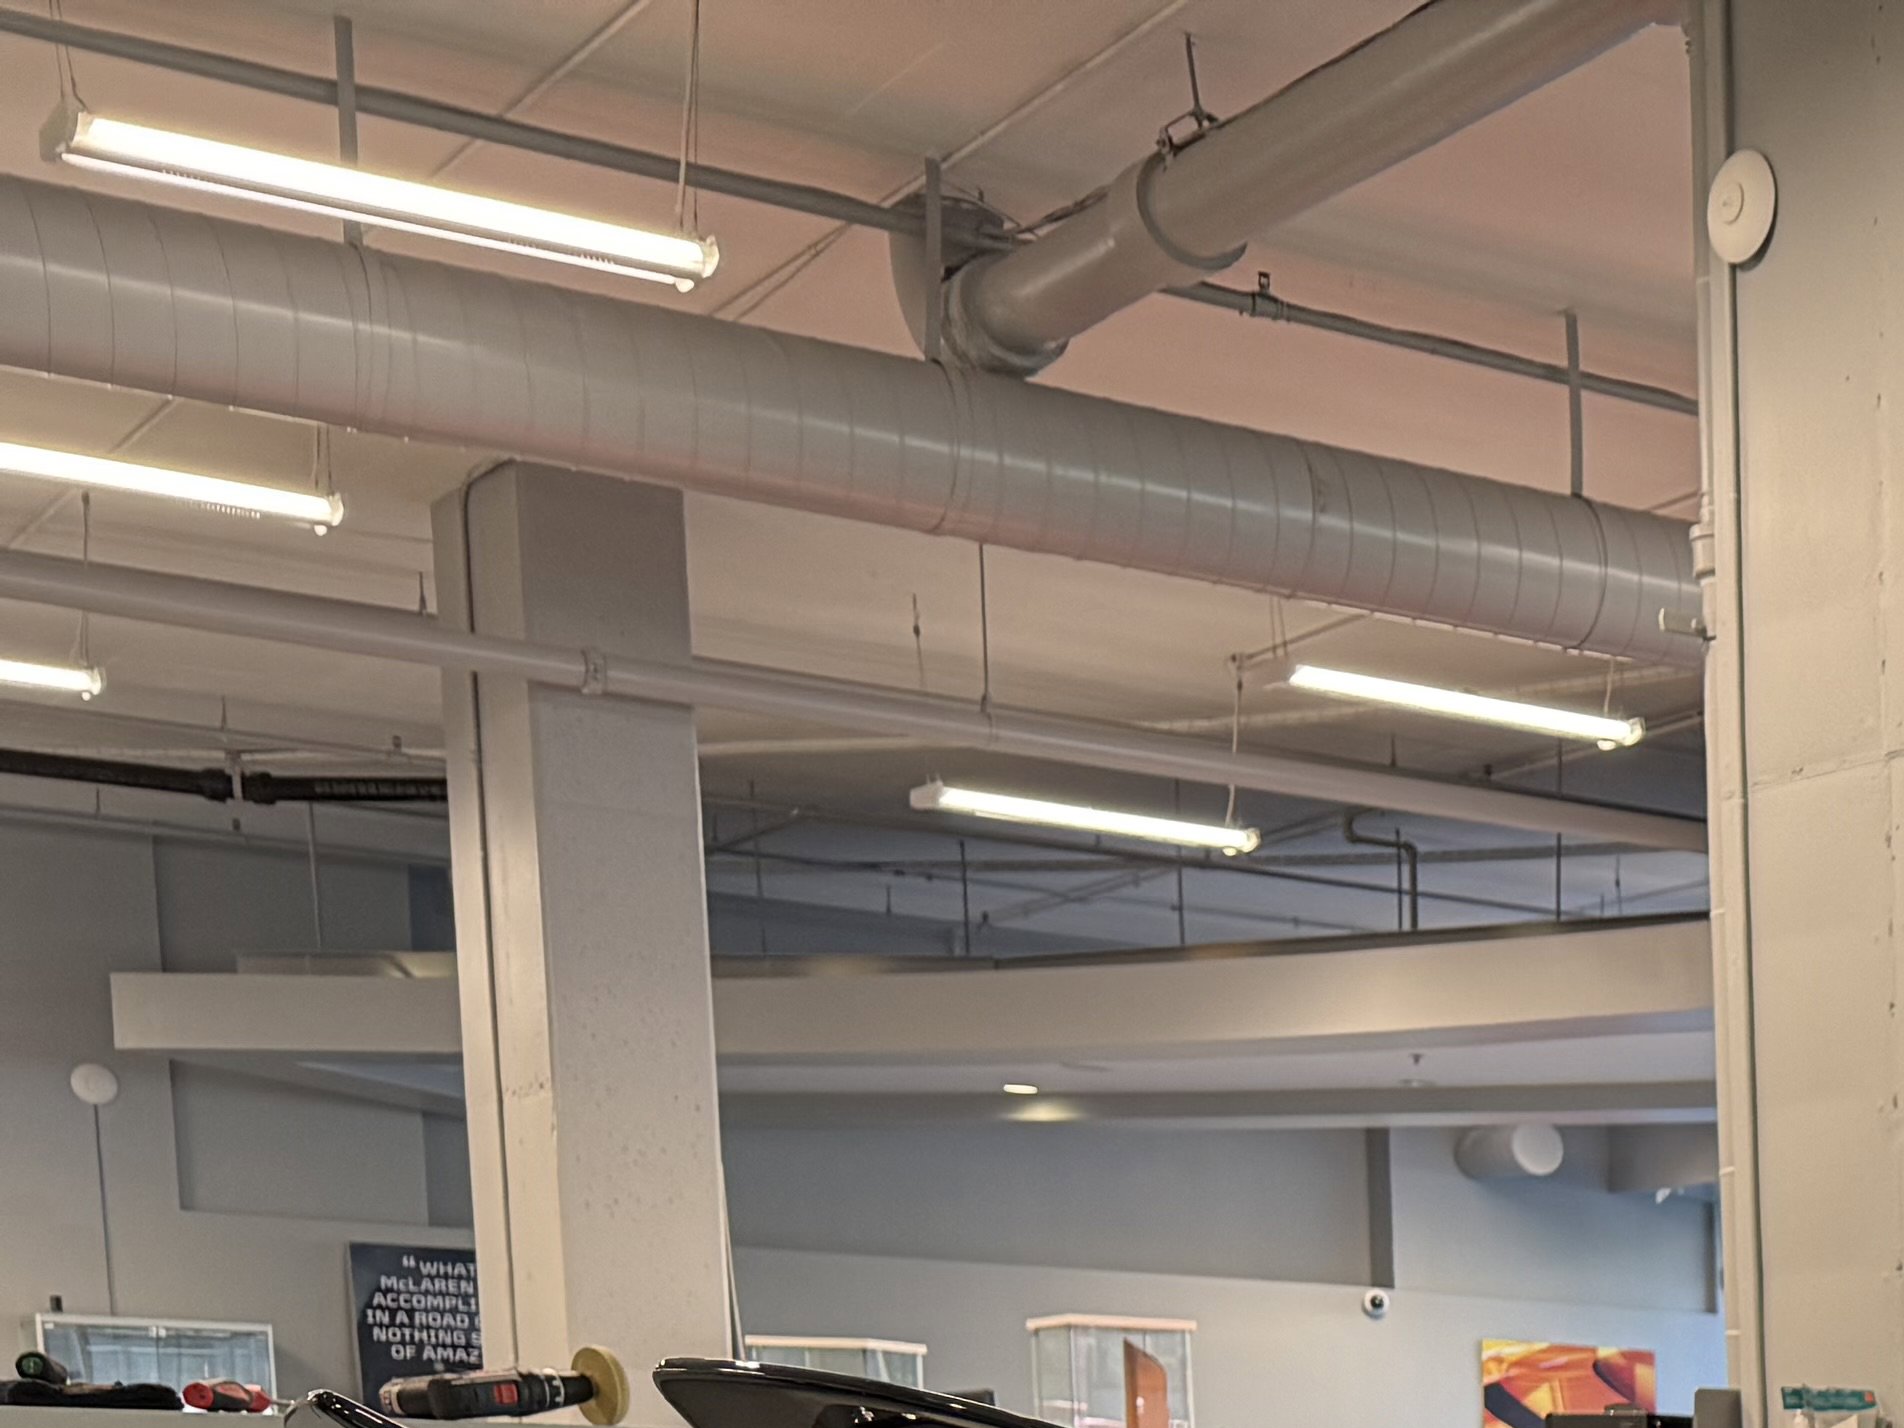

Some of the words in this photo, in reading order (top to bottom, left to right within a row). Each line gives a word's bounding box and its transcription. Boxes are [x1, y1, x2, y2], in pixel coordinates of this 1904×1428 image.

[380, 1275, 474, 1294] McLAREN
[366, 1309, 389, 1325] IN
[395, 1310, 410, 1325] A
[414, 1311, 469, 1329] ROAD
[372, 1326, 466, 1345] NOTHING
[390, 1344, 416, 1360] OF
